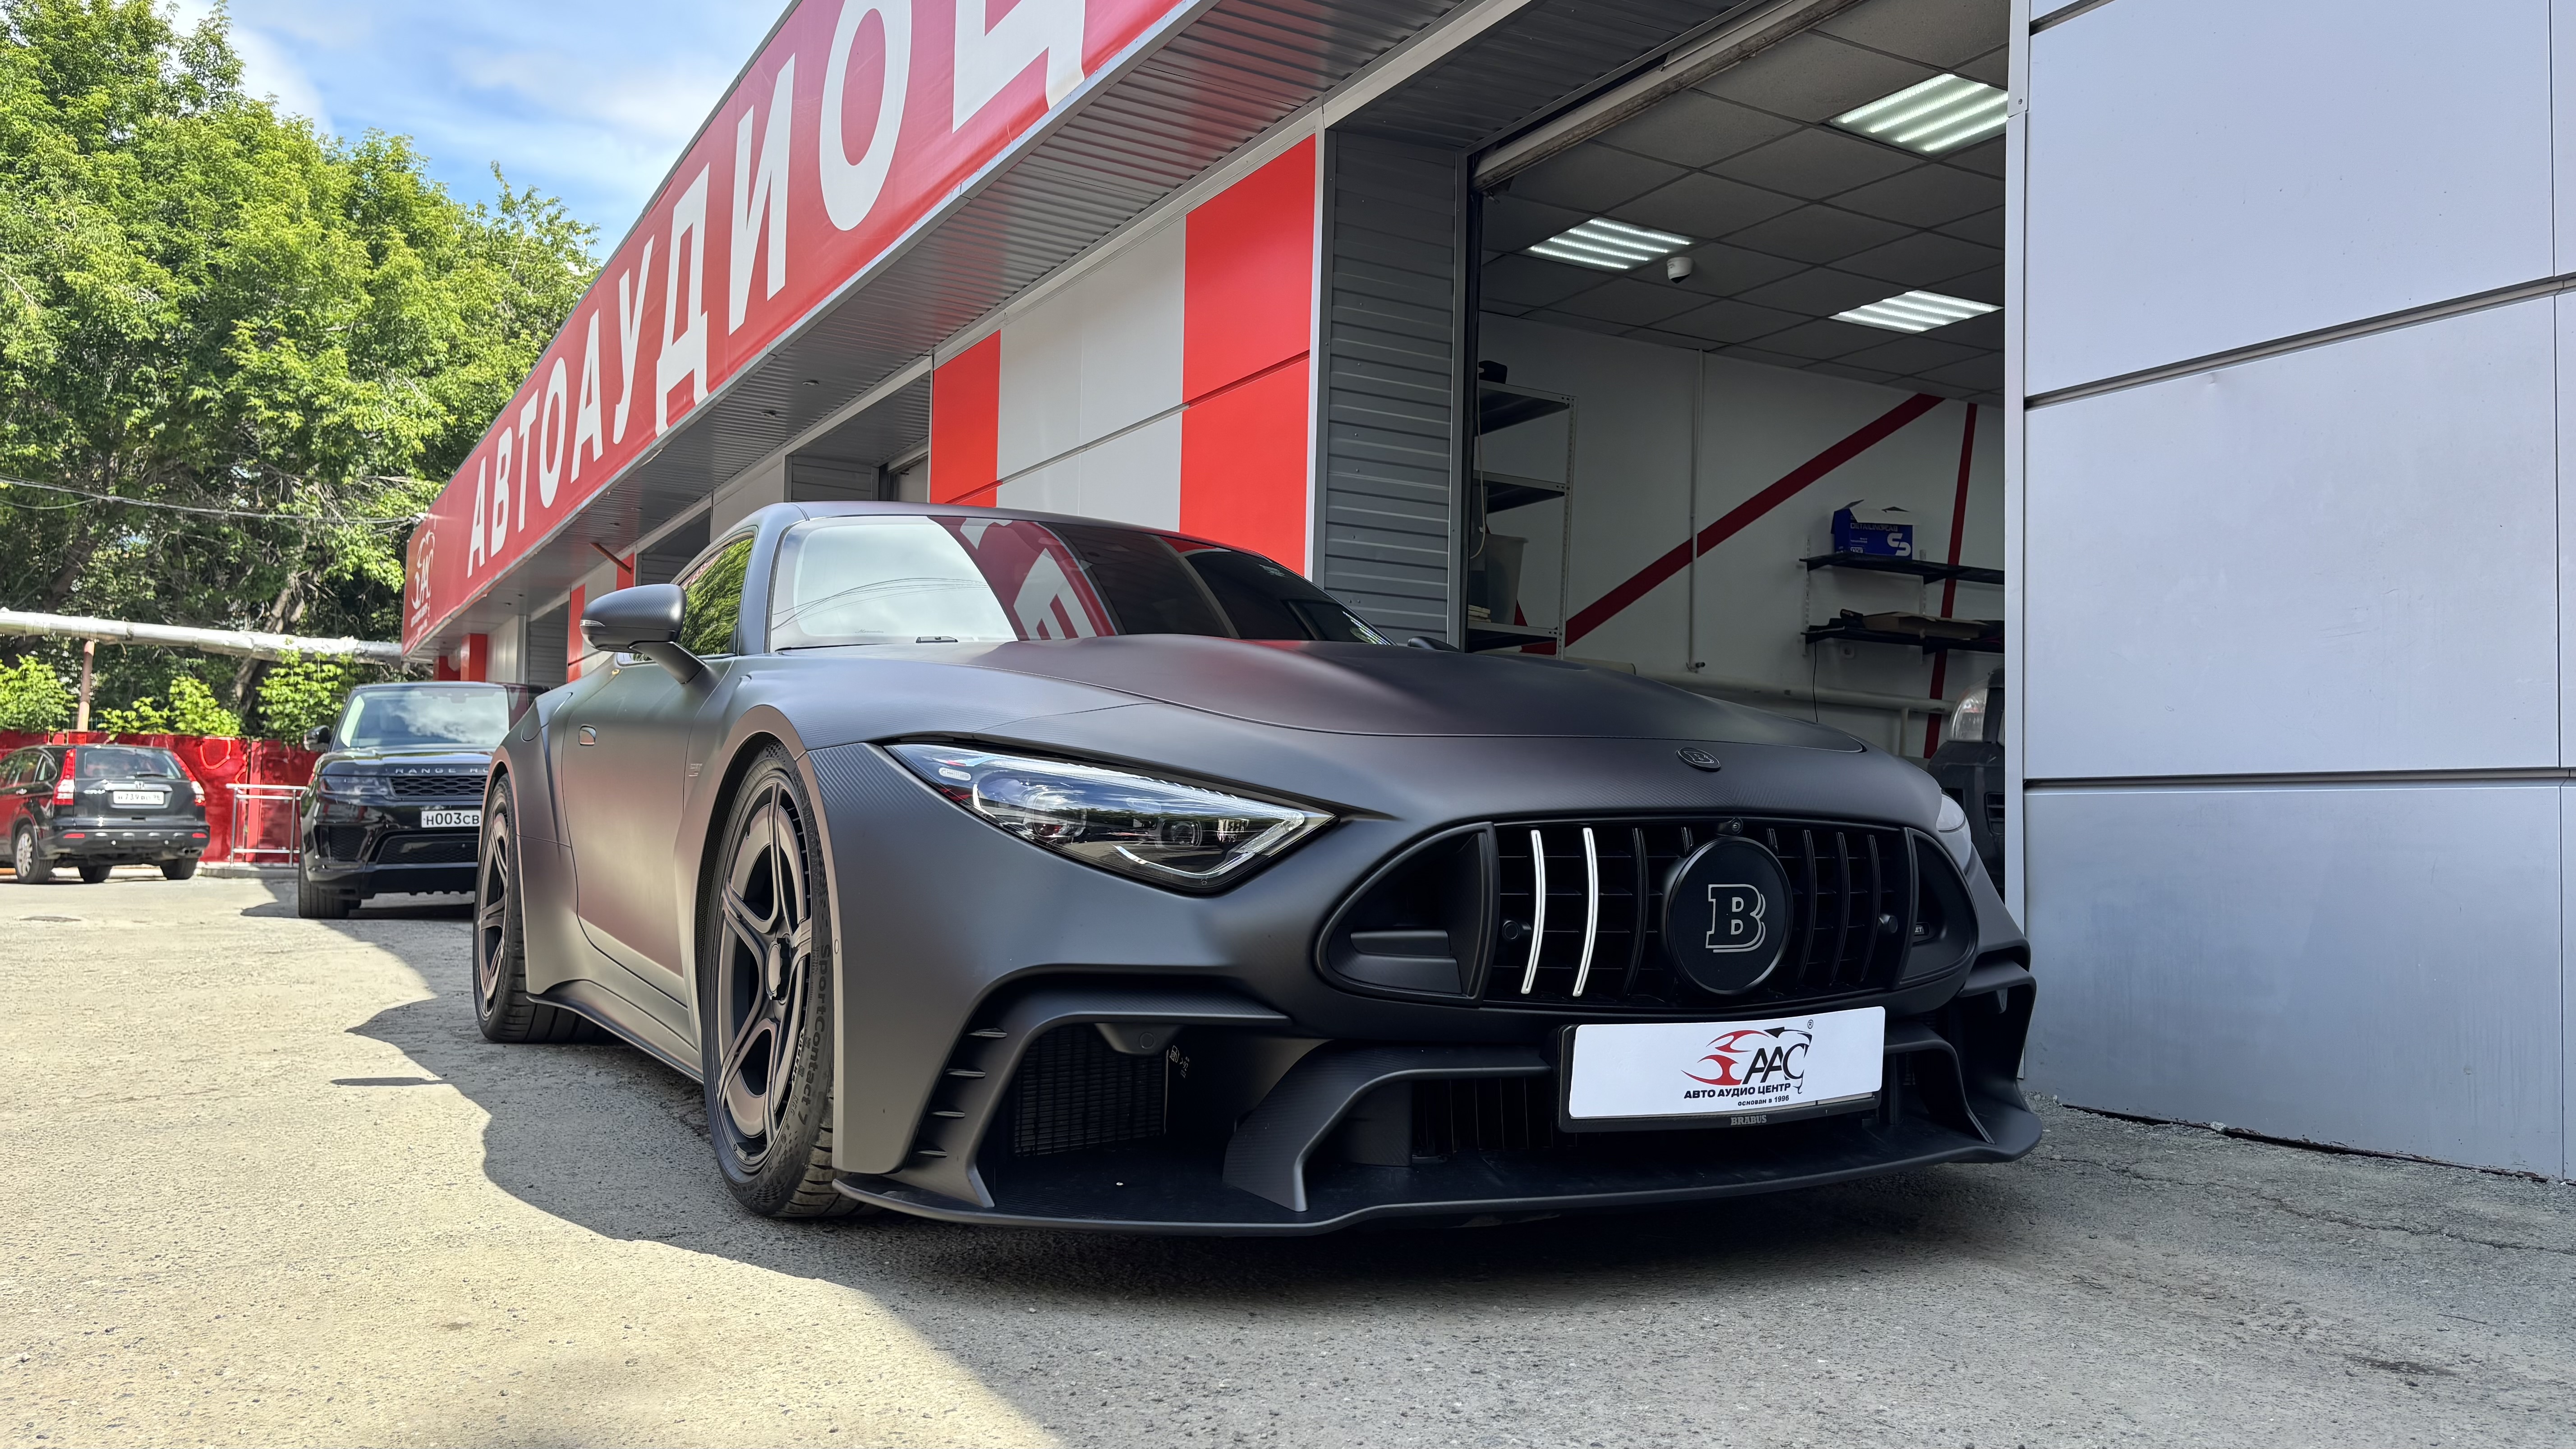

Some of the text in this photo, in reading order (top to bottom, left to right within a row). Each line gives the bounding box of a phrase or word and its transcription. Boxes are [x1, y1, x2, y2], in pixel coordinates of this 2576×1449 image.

[1706, 883, 1767, 953] B
[801, 944, 832, 1110] SportContact
[1684, 1083, 1791, 1099] АВТО АУДИО ЦЕНТР
[797, 1110, 809, 1126] 7
[1730, 1115, 1767, 1126] BRABUS
